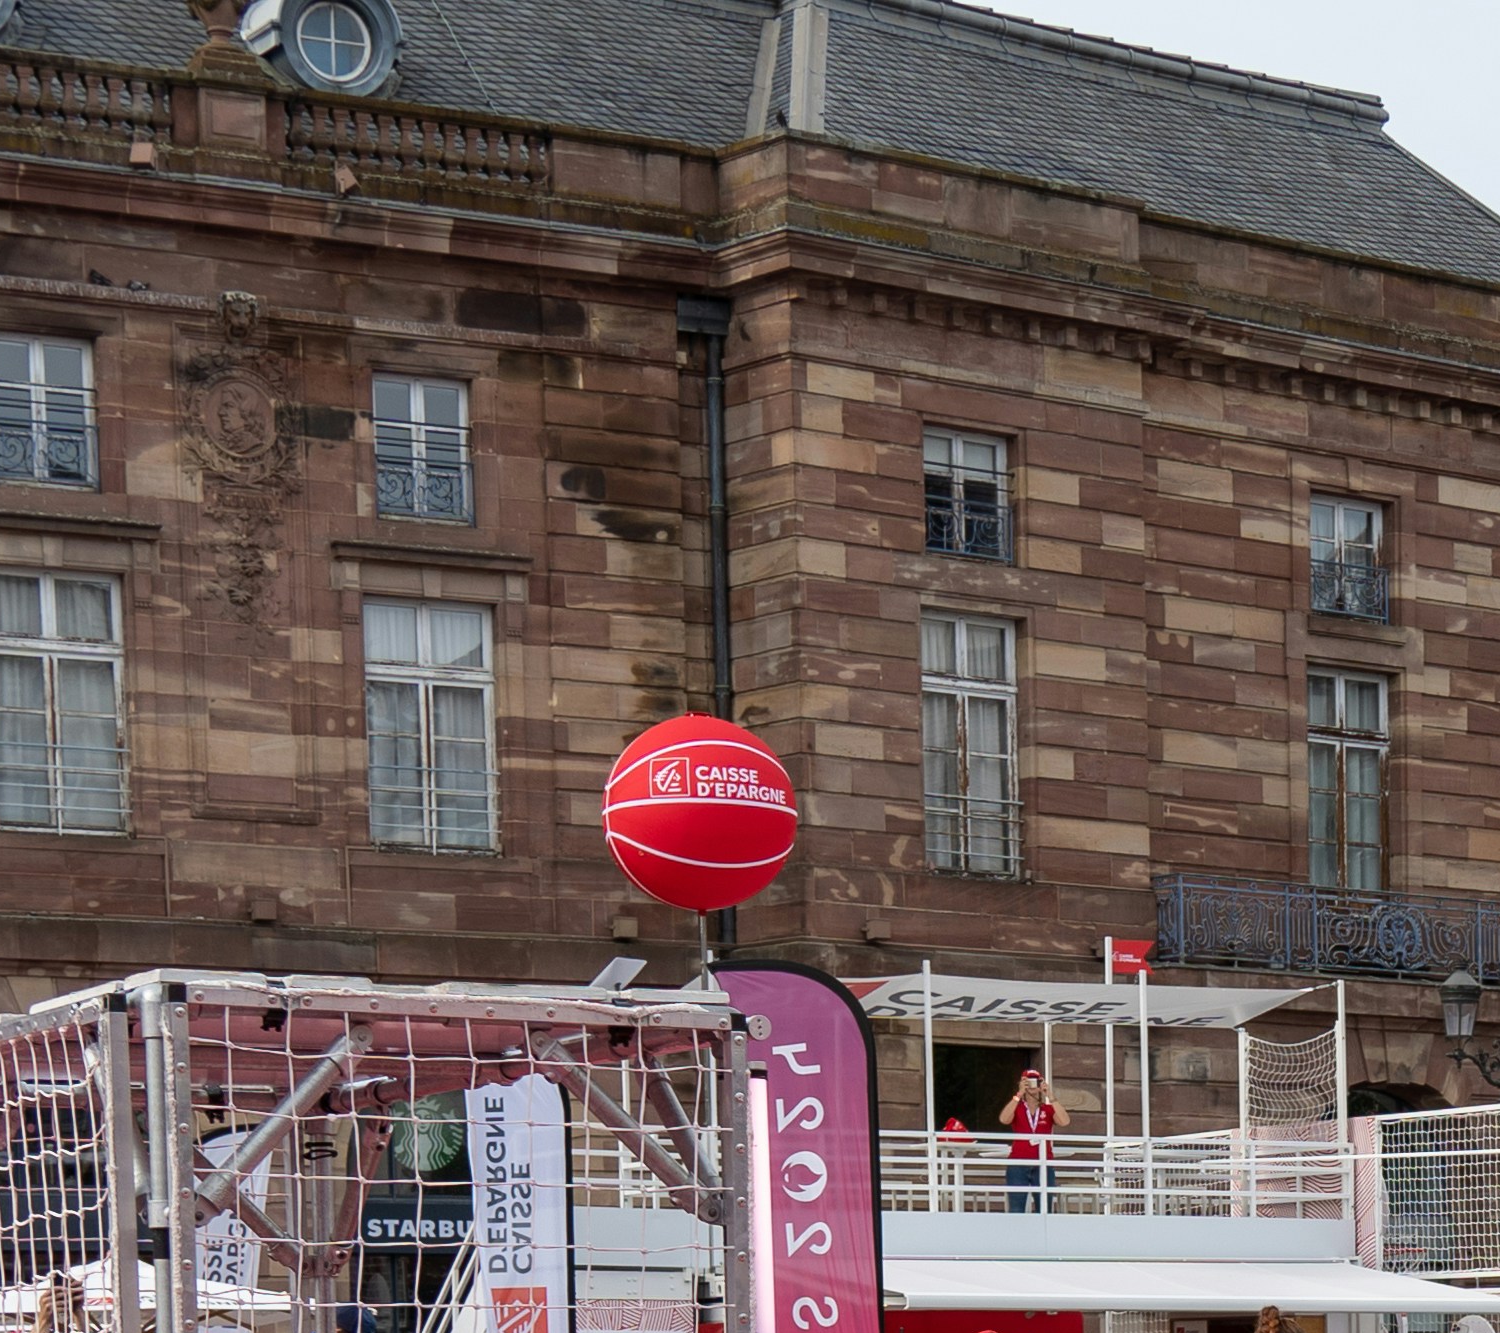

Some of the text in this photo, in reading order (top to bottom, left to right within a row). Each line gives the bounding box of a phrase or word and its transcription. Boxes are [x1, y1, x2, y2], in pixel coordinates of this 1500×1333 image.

[695, 765, 759, 785] CAISSE
[696, 782, 787, 805] D'EPARGNE
[888, 990, 1127, 1015] CAISSE
